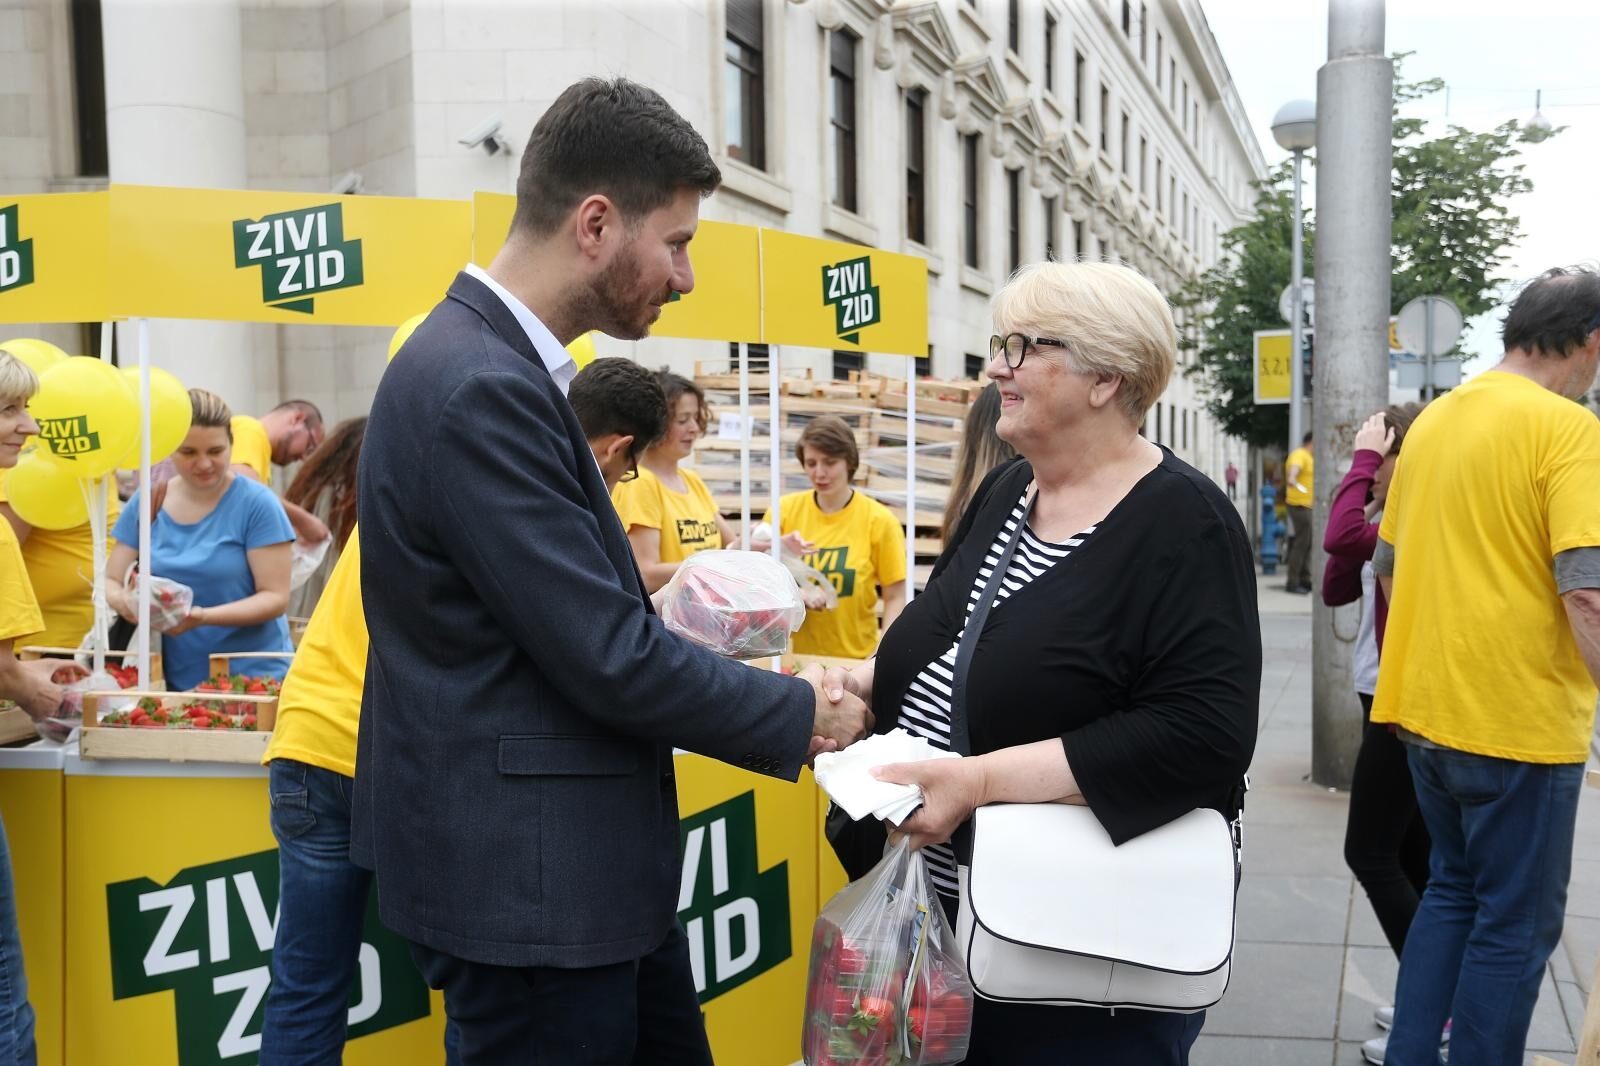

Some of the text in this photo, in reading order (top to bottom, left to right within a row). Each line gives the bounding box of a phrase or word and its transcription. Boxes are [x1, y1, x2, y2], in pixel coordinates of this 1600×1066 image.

[246, 211, 327, 259] ZIVI
[276, 249, 345, 294] ZID
[827, 262, 865, 299] ZIVI
[841, 293, 873, 328] ZID
[54, 437, 91, 453] ZID
[804, 550, 839, 571] IVI
[138, 871, 281, 977] ZIV
[686, 896, 760, 994] ID
